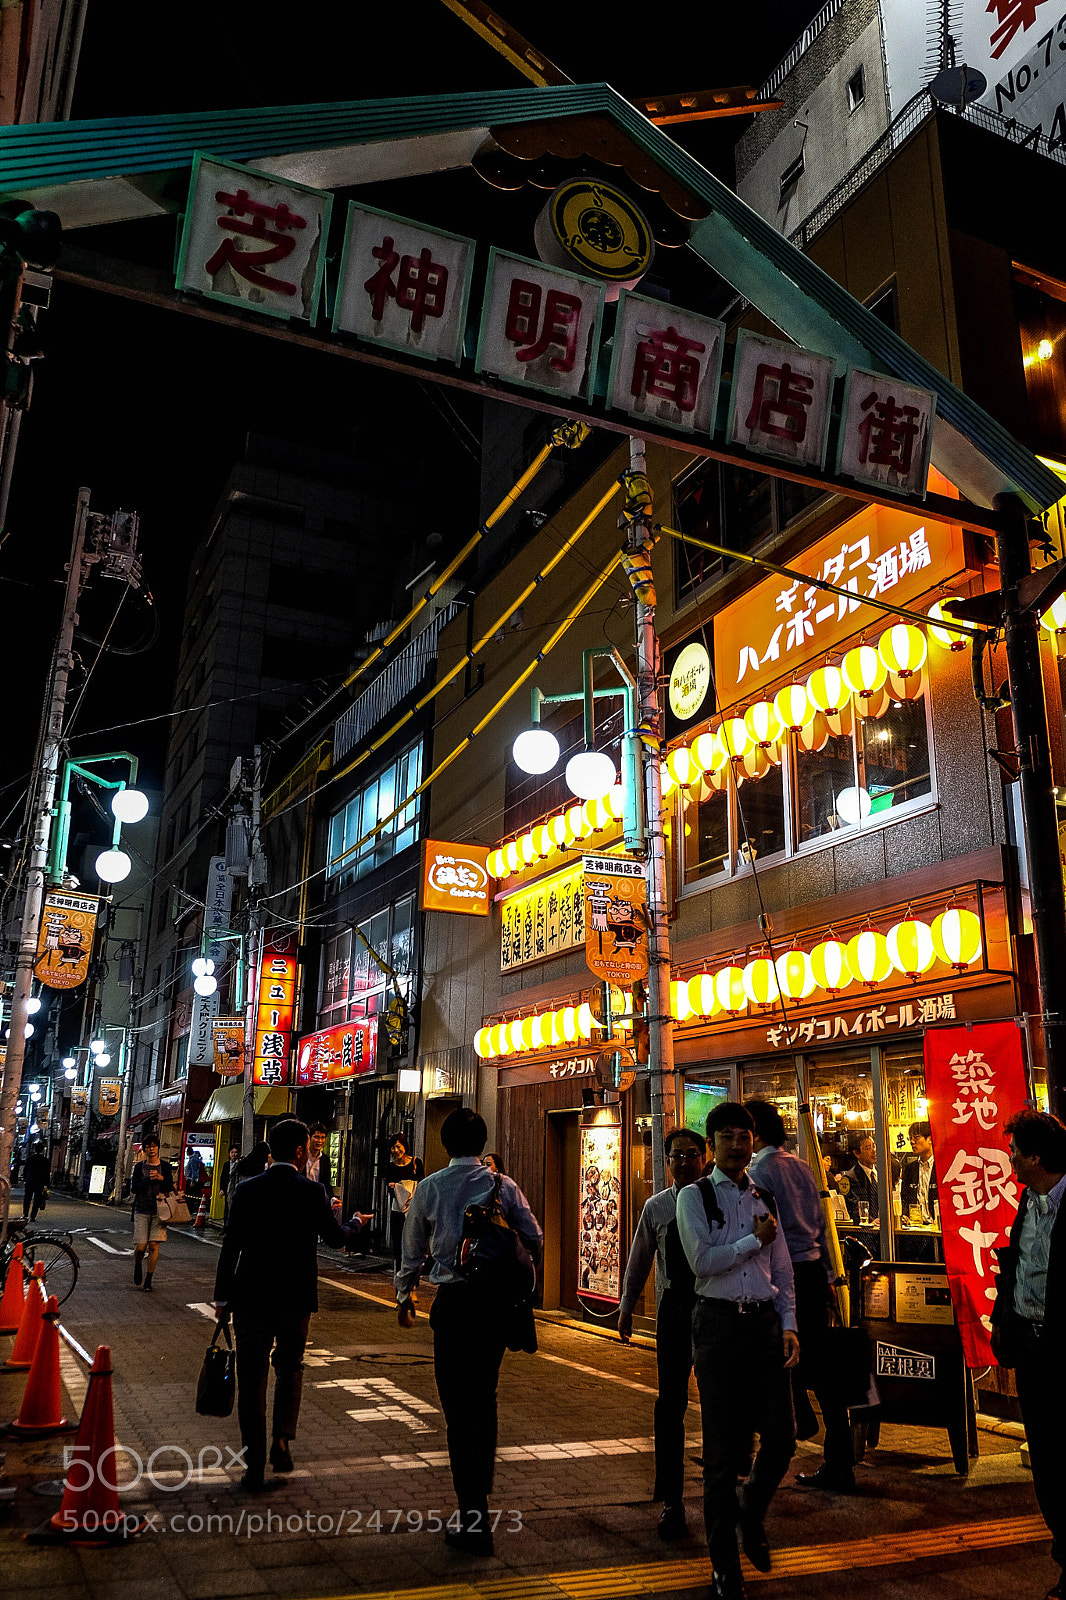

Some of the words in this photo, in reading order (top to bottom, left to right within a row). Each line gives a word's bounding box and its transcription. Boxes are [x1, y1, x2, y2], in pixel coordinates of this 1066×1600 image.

[775, 534, 871, 613] ギンダコ
[735, 526, 932, 684] ハイボール酒場
[584, 859, 643, 875] 芝神明商店会
[48, 896, 97, 911] 芝神明商店会
[50, 978, 70, 986] TOKYO
[606, 970, 631, 979] TOKYO
[260, 959, 288, 1085] ニュー浅草
[766, 994, 957, 1048] ギンダコハイボール酒場
[878, 1347, 898, 1356] BAR
